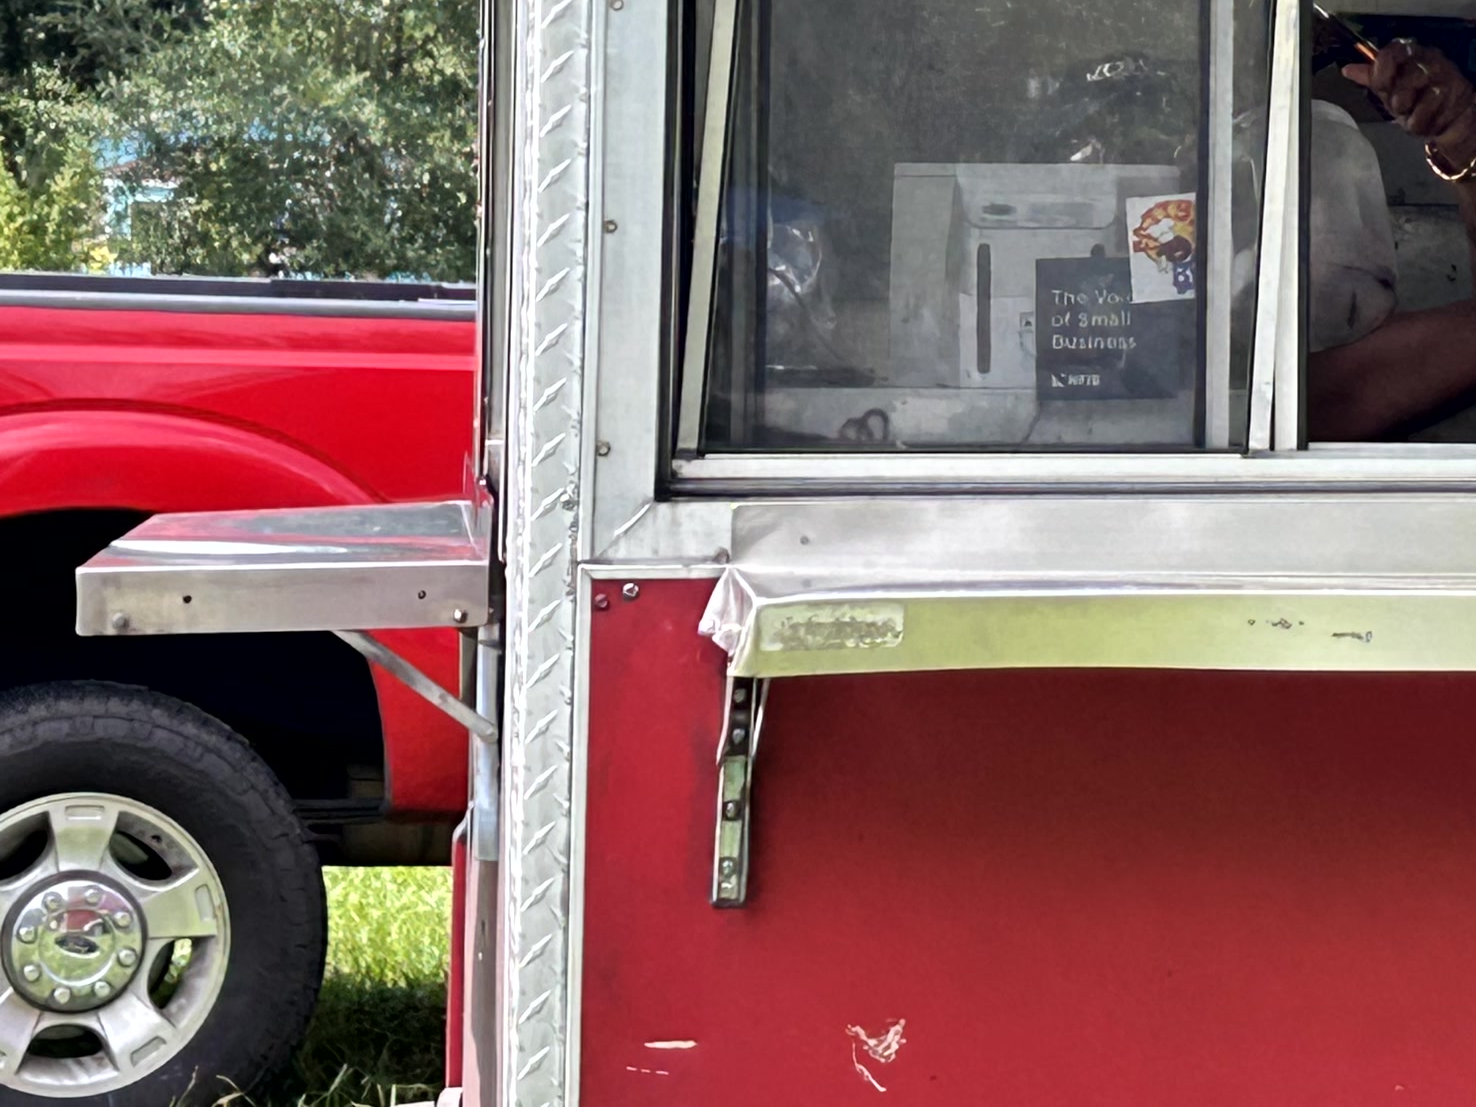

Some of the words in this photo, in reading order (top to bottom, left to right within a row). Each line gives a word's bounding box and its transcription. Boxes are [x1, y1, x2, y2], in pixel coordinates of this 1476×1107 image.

[1052, 289, 1088, 306] The
[1052, 313, 1070, 327] of
[1079, 311, 1131, 328] Small
[1052, 334, 1136, 350] Business
